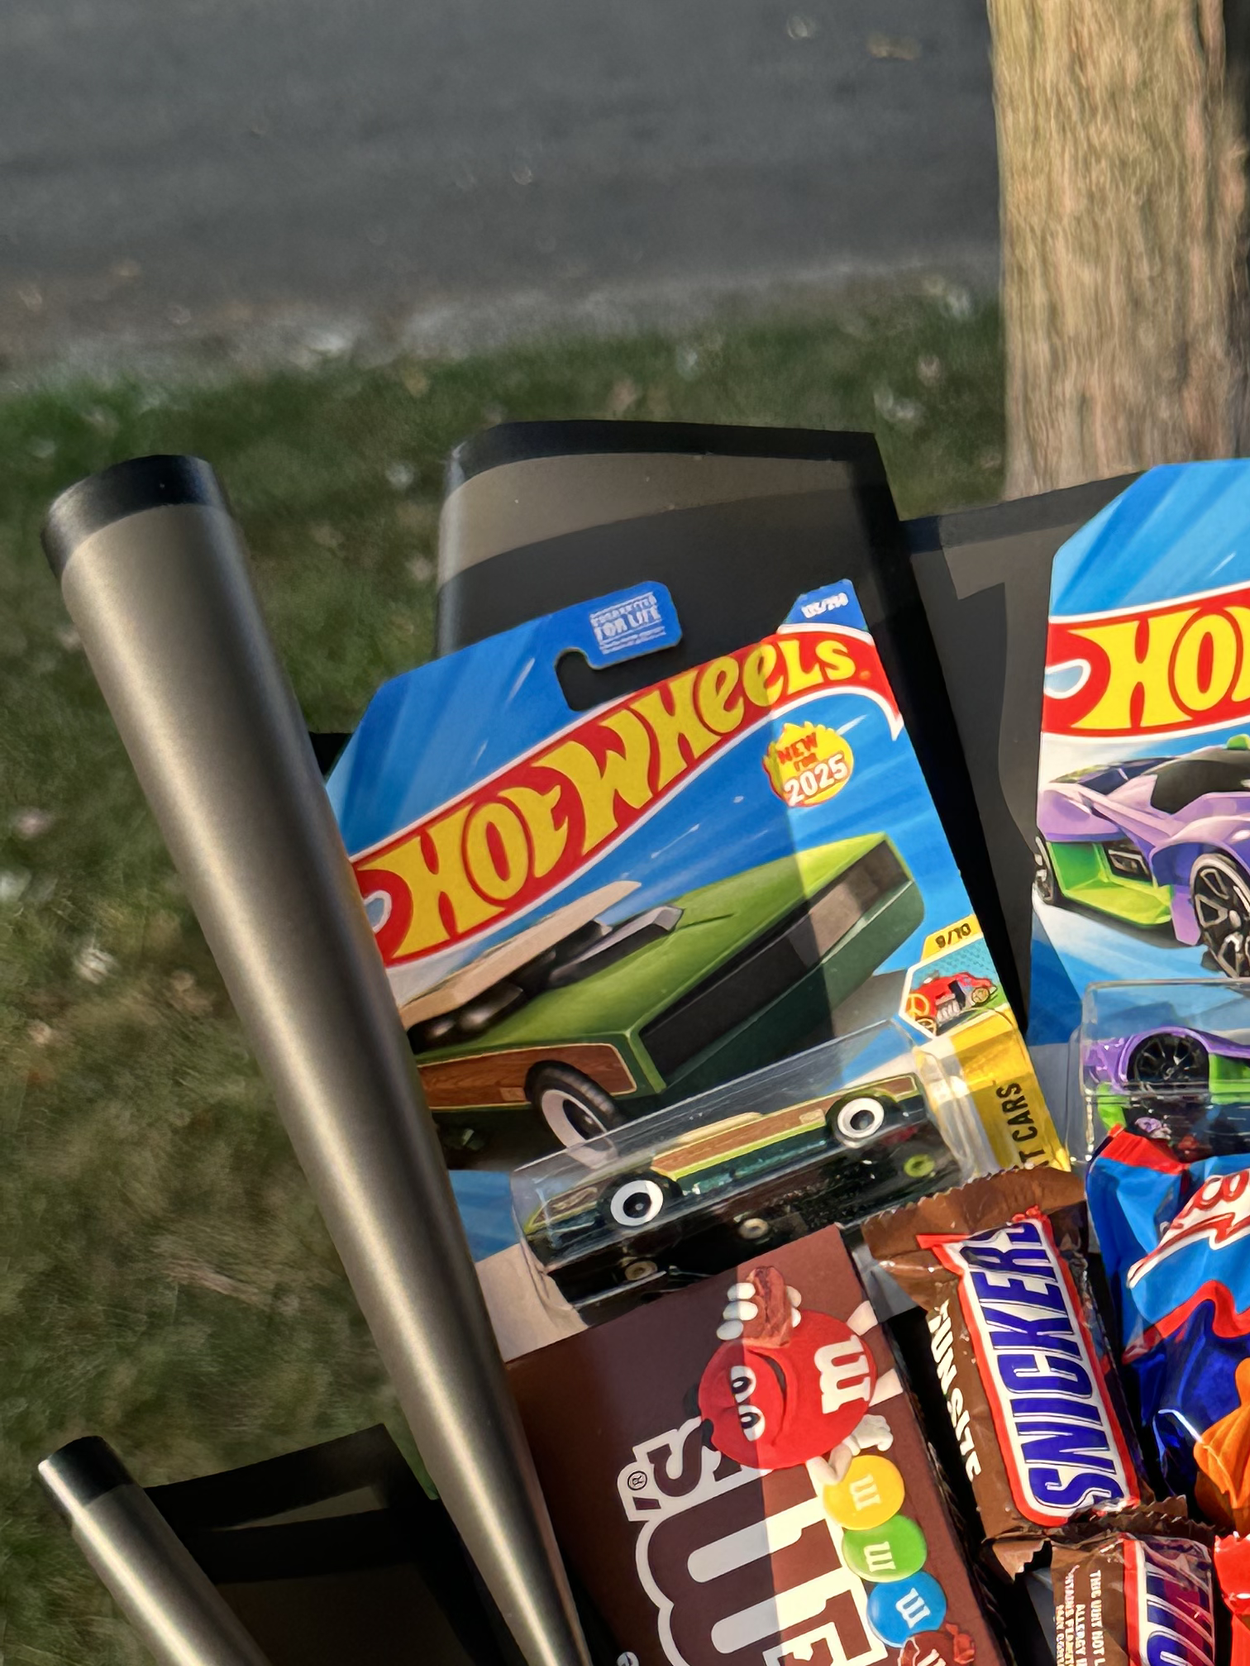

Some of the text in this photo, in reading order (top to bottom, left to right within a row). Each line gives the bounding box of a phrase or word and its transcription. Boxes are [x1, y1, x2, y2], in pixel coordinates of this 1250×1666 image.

[777, 731, 818, 765] NEW
[784, 752, 848, 807] 2025
[357, 786, 568, 958] HOT
[935, 923, 971, 948] 9/10
[995, 1083, 1038, 1142] CARS
[927, 1299, 958, 1395] FUN
[814, 1335, 872, 1414] m
[849, 1474, 882, 1511] m
[863, 1541, 897, 1573] m
[895, 1588, 932, 1629] m
